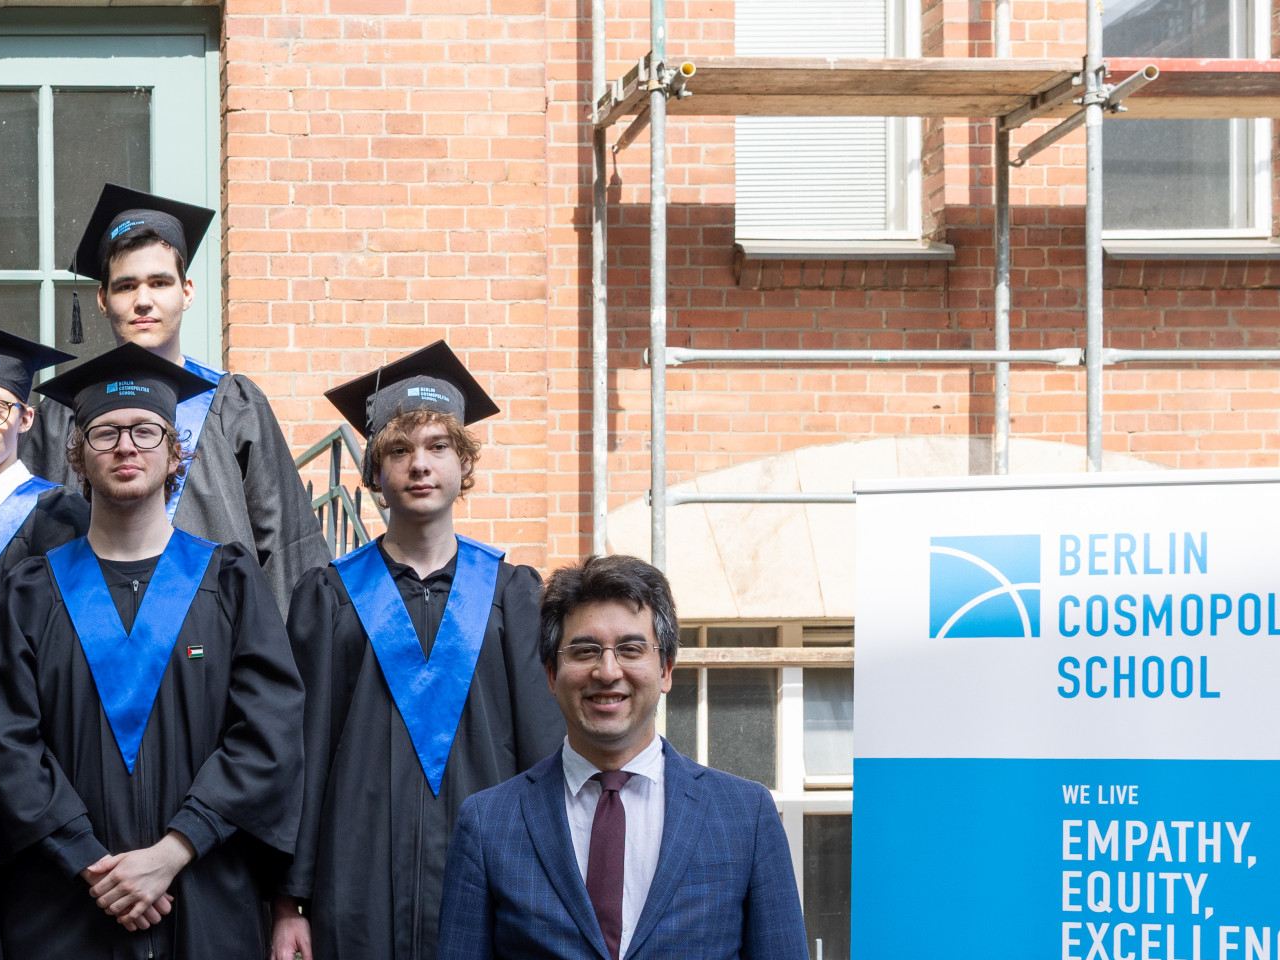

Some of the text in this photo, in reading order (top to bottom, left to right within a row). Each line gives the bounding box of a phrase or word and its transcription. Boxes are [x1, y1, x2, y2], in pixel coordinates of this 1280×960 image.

[118, 385, 150, 393] COSMOPOLITAN
[420, 391, 450, 402] COSMOPOLITAN
[1059, 531, 1208, 576] BERLIN
[1058, 592, 1280, 638] COSMOPOL
[1058, 655, 1221, 699] SCHOOL
[1062, 784, 1139, 805] WE LIVE
[1062, 819, 1257, 869] EMPATHY,
[1062, 870, 1214, 920] EQUITY,
